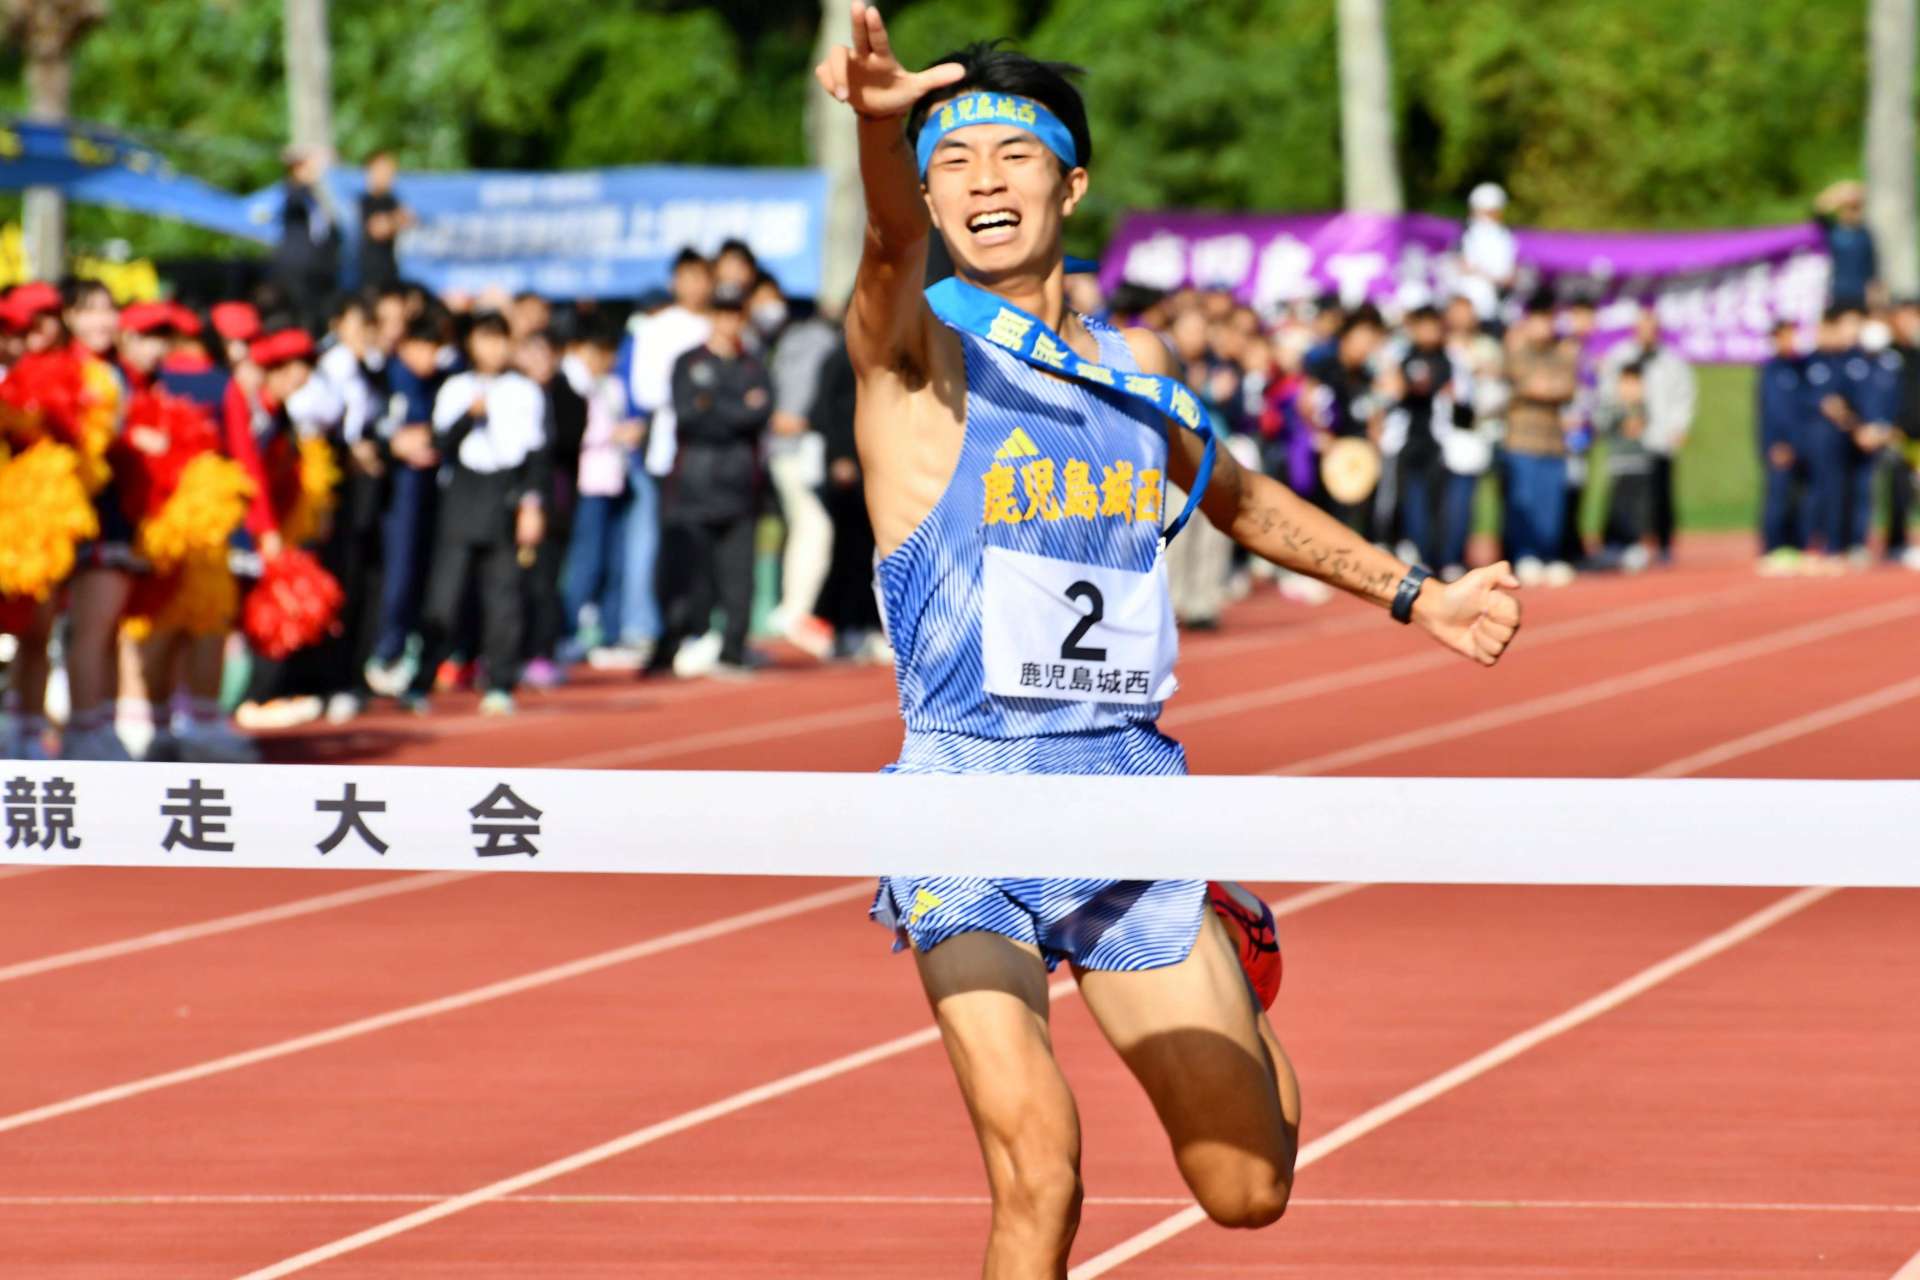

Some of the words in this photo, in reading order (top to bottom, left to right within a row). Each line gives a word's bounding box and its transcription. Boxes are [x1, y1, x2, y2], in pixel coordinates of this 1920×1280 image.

[982, 457, 1162, 524] 鹿児島城西
[1060, 580, 1107, 662] 2
[1019, 662, 1151, 695] 鹿児島城西
[3, 776, 544, 858] 競走大会
